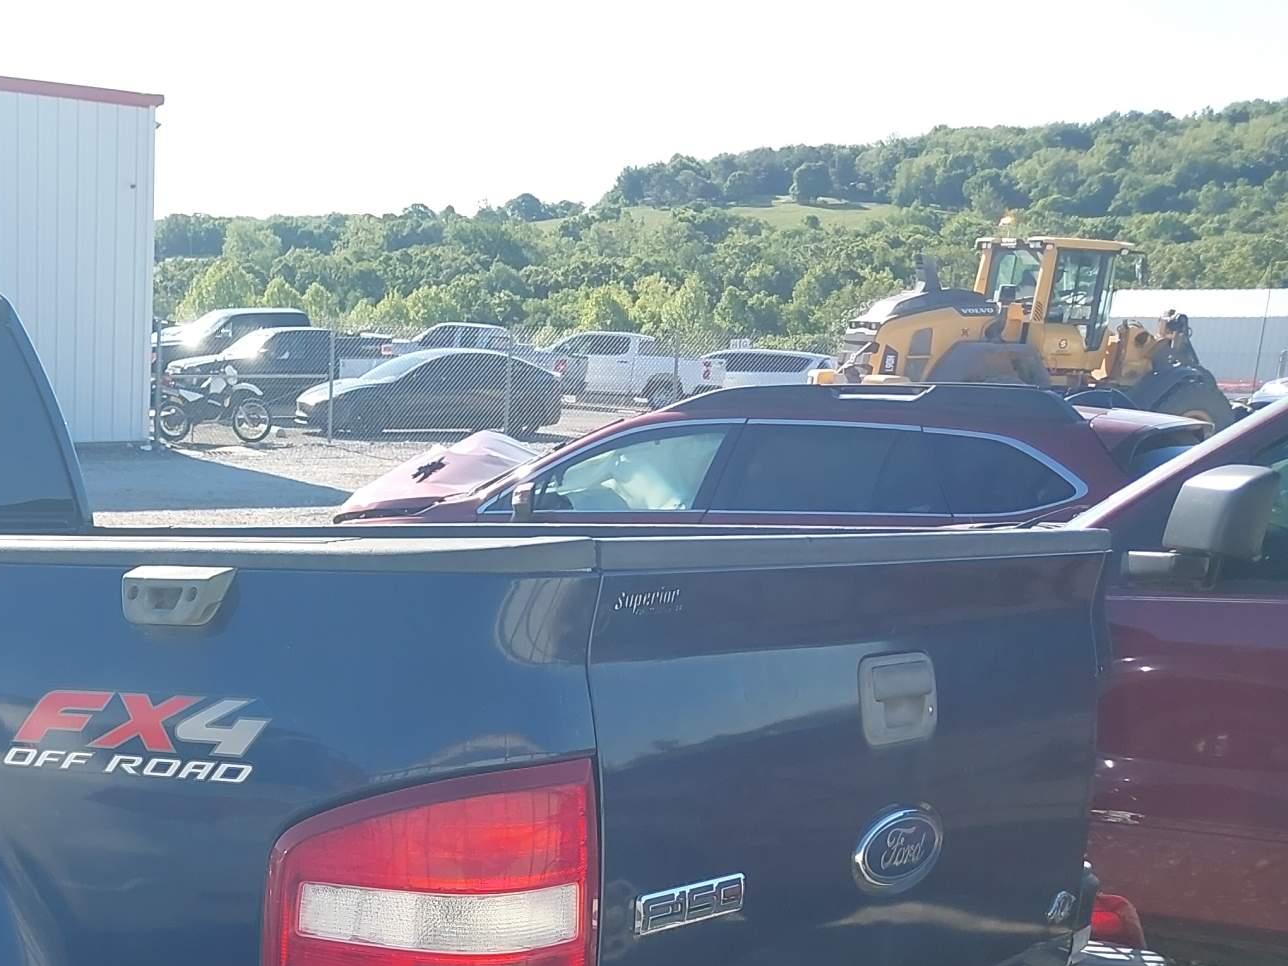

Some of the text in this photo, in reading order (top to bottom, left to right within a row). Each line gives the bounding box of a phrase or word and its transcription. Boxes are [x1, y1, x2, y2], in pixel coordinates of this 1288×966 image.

[961, 307, 994, 315] VOLVO
[614, 586, 680, 614] Superior
[12, 690, 273, 758] FX4
[3, 747, 253, 783] OFF ROAD
[880, 825, 926, 870] Ford
